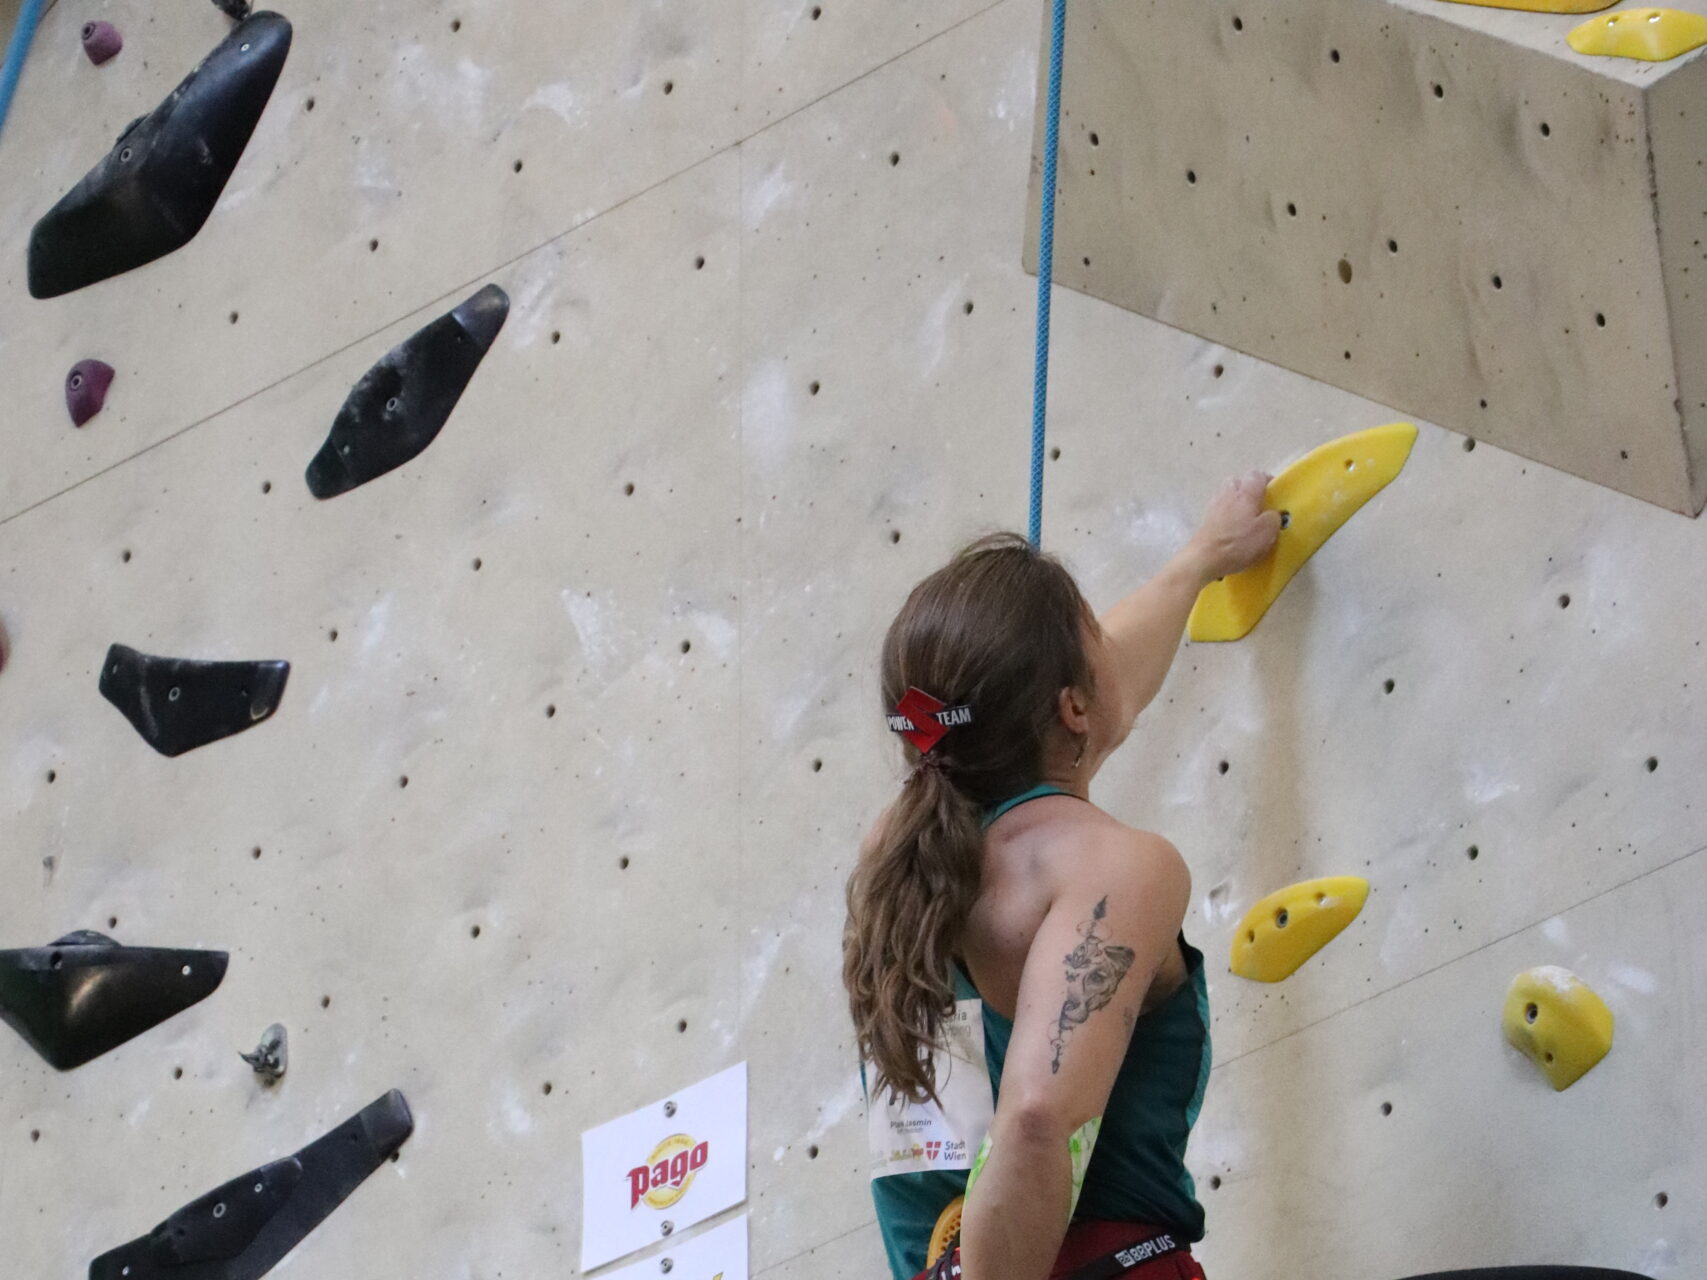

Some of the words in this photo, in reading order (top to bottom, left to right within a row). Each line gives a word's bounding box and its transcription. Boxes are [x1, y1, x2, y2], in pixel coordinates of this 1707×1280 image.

[936, 708, 972, 726] TEAM
[945, 1140, 966, 1150] Stadt
[944, 1151, 967, 1161] Wien
[626, 1140, 709, 1209] pago
